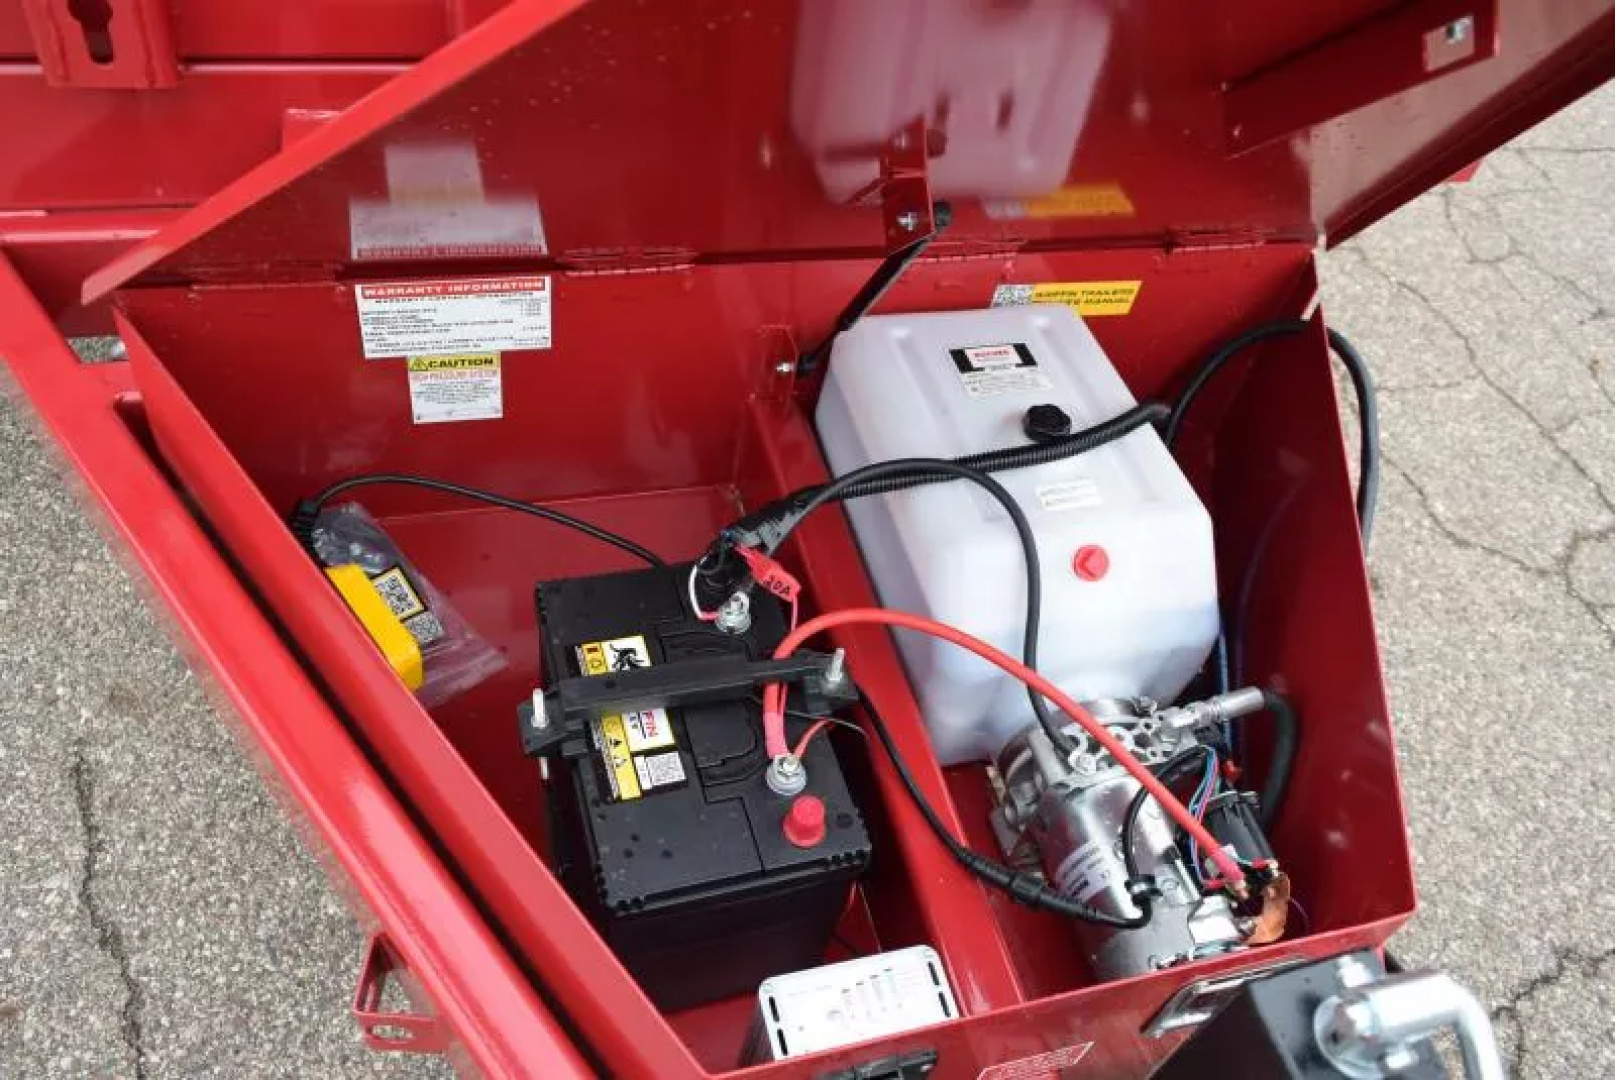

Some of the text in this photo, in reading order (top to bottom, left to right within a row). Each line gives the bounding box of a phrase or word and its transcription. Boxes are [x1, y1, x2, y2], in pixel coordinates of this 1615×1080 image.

[364, 281, 542, 296] WARRANTY INFORMATION
[427, 357, 495, 369] CAUTION
